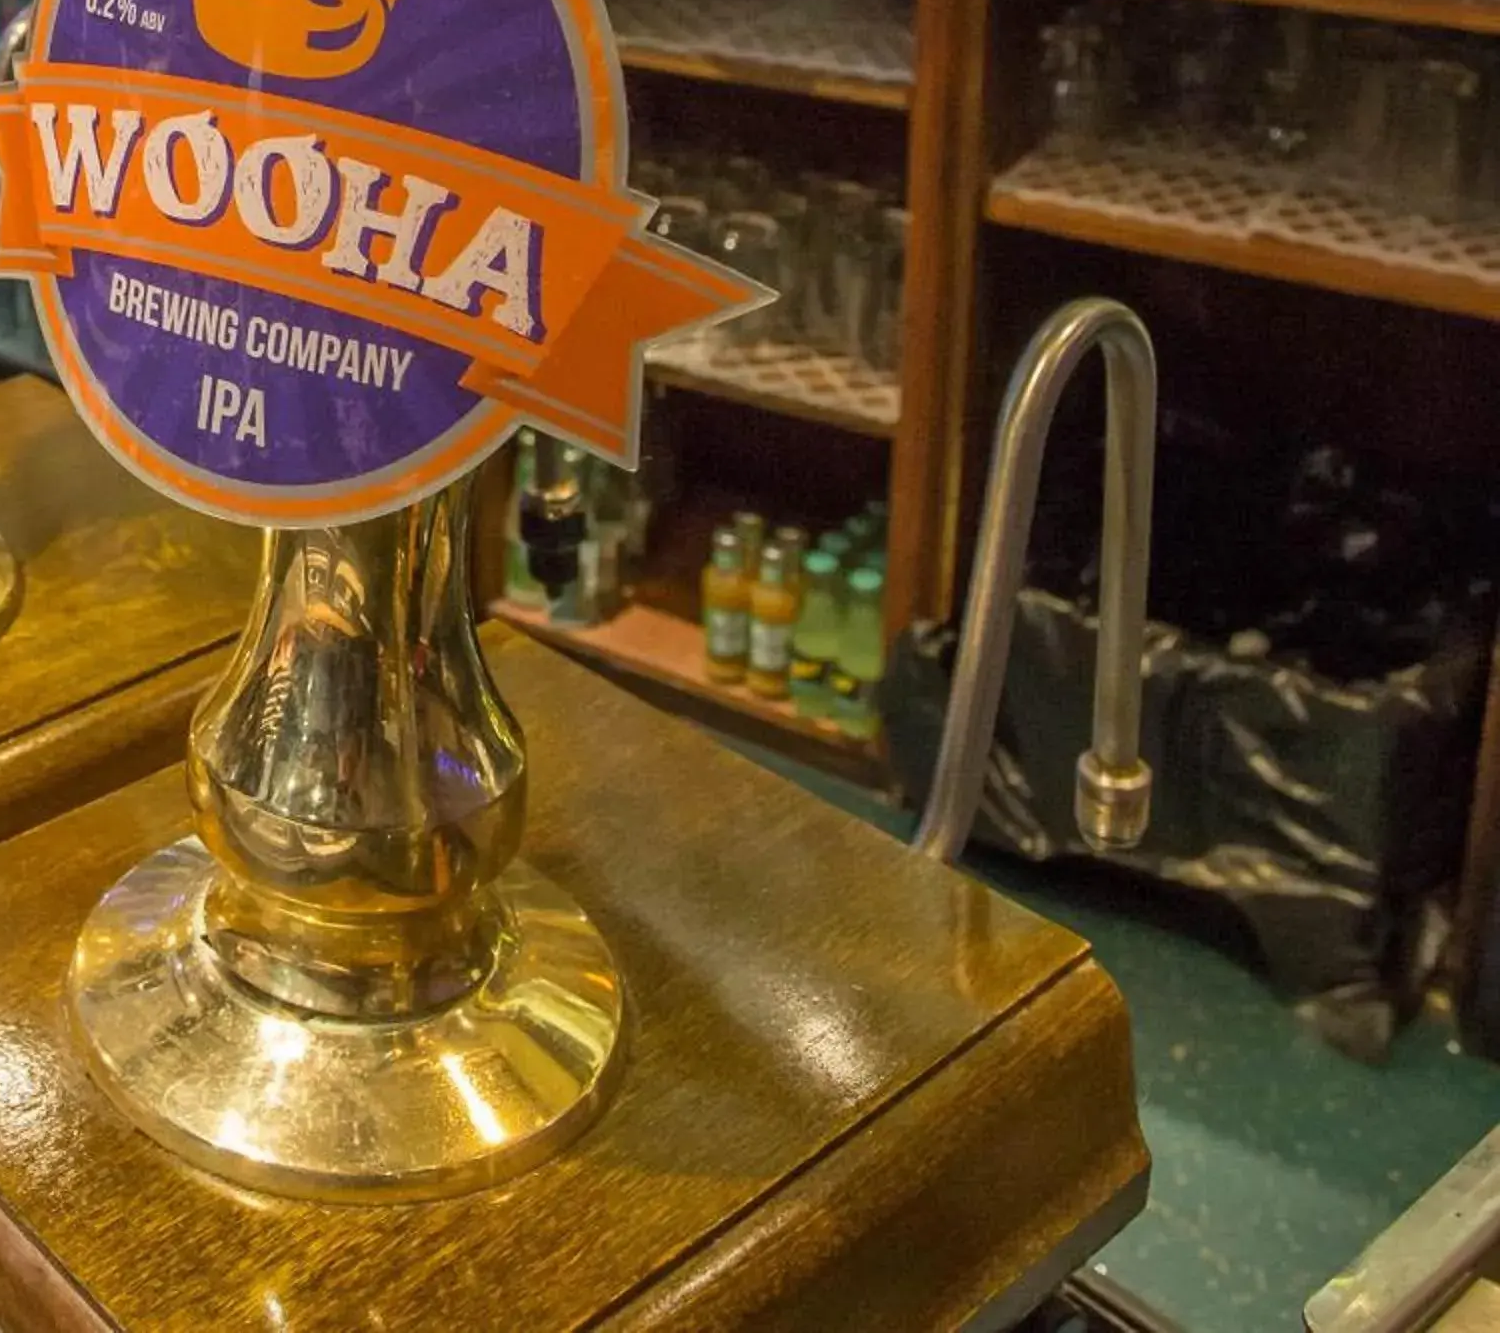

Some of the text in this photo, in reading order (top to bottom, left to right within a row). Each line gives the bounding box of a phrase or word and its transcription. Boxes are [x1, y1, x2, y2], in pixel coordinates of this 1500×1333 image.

[140, 10, 165, 33] ABV
[31, 103, 544, 342] WOOHA
[108, 272, 414, 392] BREWING COMPANY
[197, 374, 267, 448] IPA
